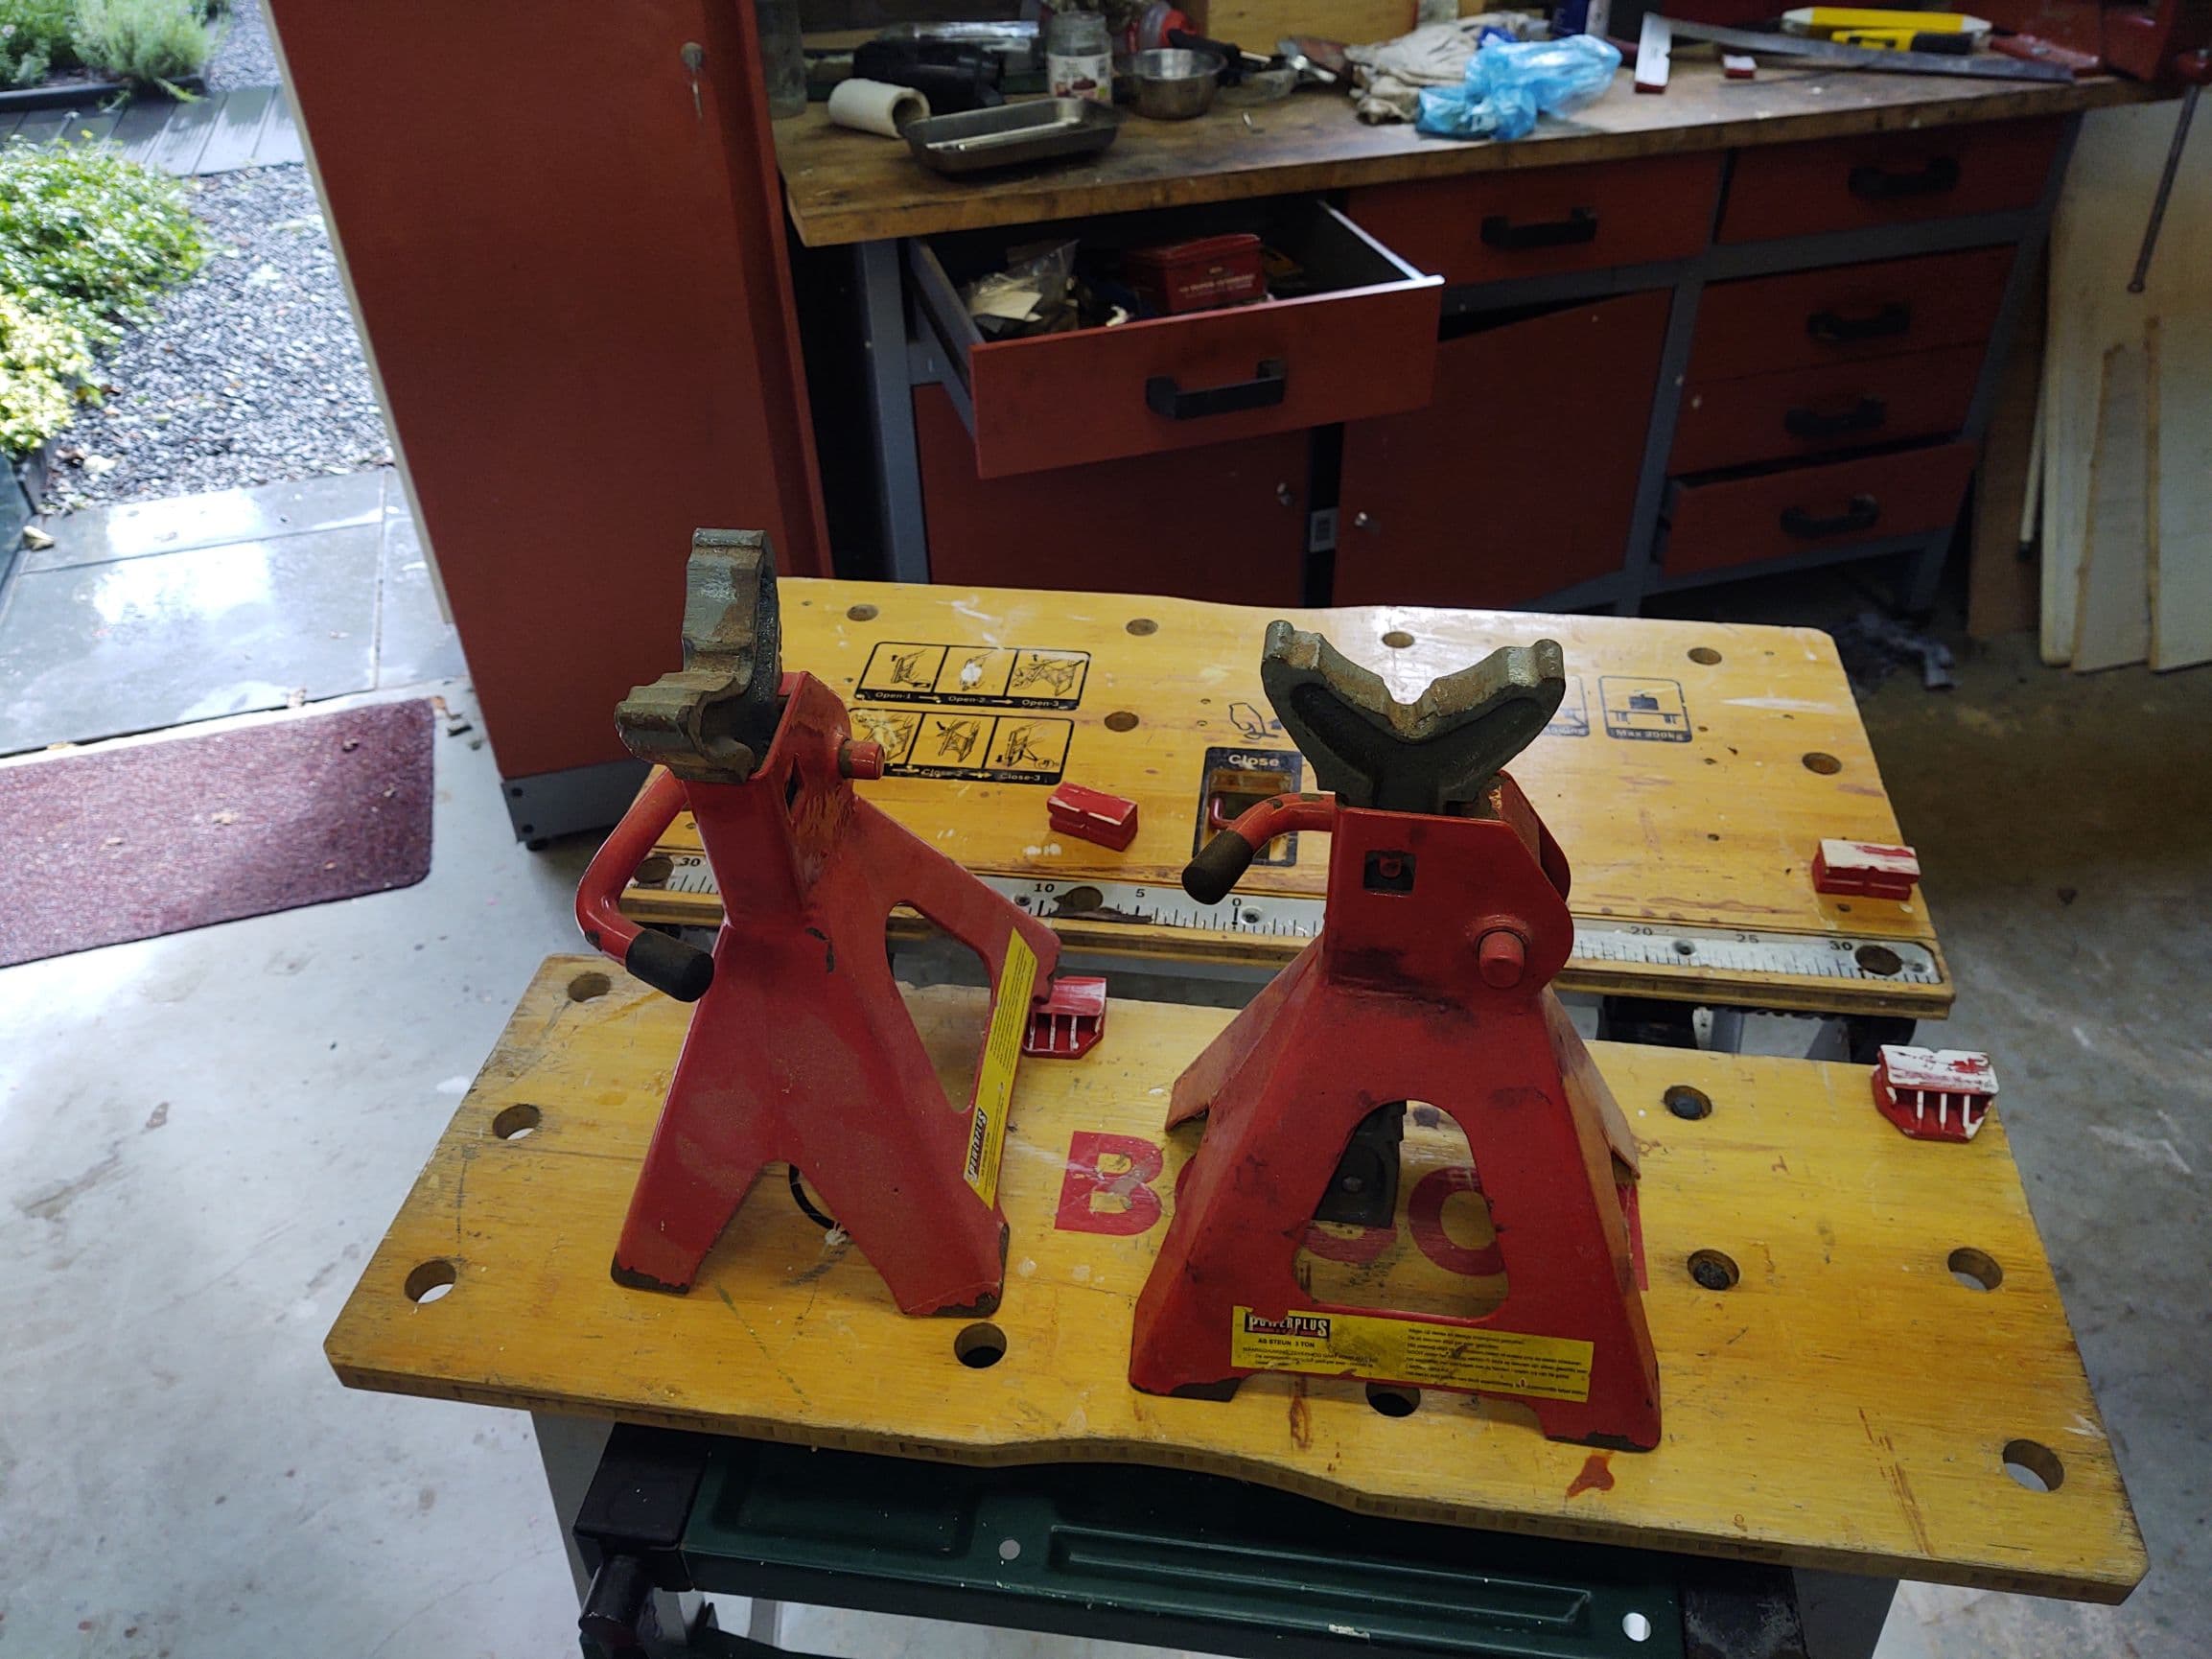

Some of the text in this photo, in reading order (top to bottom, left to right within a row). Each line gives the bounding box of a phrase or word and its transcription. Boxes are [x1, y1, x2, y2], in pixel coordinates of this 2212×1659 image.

[874, 691, 911, 700] Open-1
[948, 695, 986, 704] Open-2
[1021, 698, 1059, 708] Open-3
[1228, 754, 1280, 766] Close
[1000, 772, 1041, 782] Close-3
[680, 857, 701, 867] 30
[1034, 883, 1055, 893] 10
[1134, 888, 1146, 898] 5
[1232, 898, 1242, 907] 0
[1631, 925, 1654, 936] 20
[1735, 933, 1760, 944] 25
[1829, 940, 1854, 951] 30
